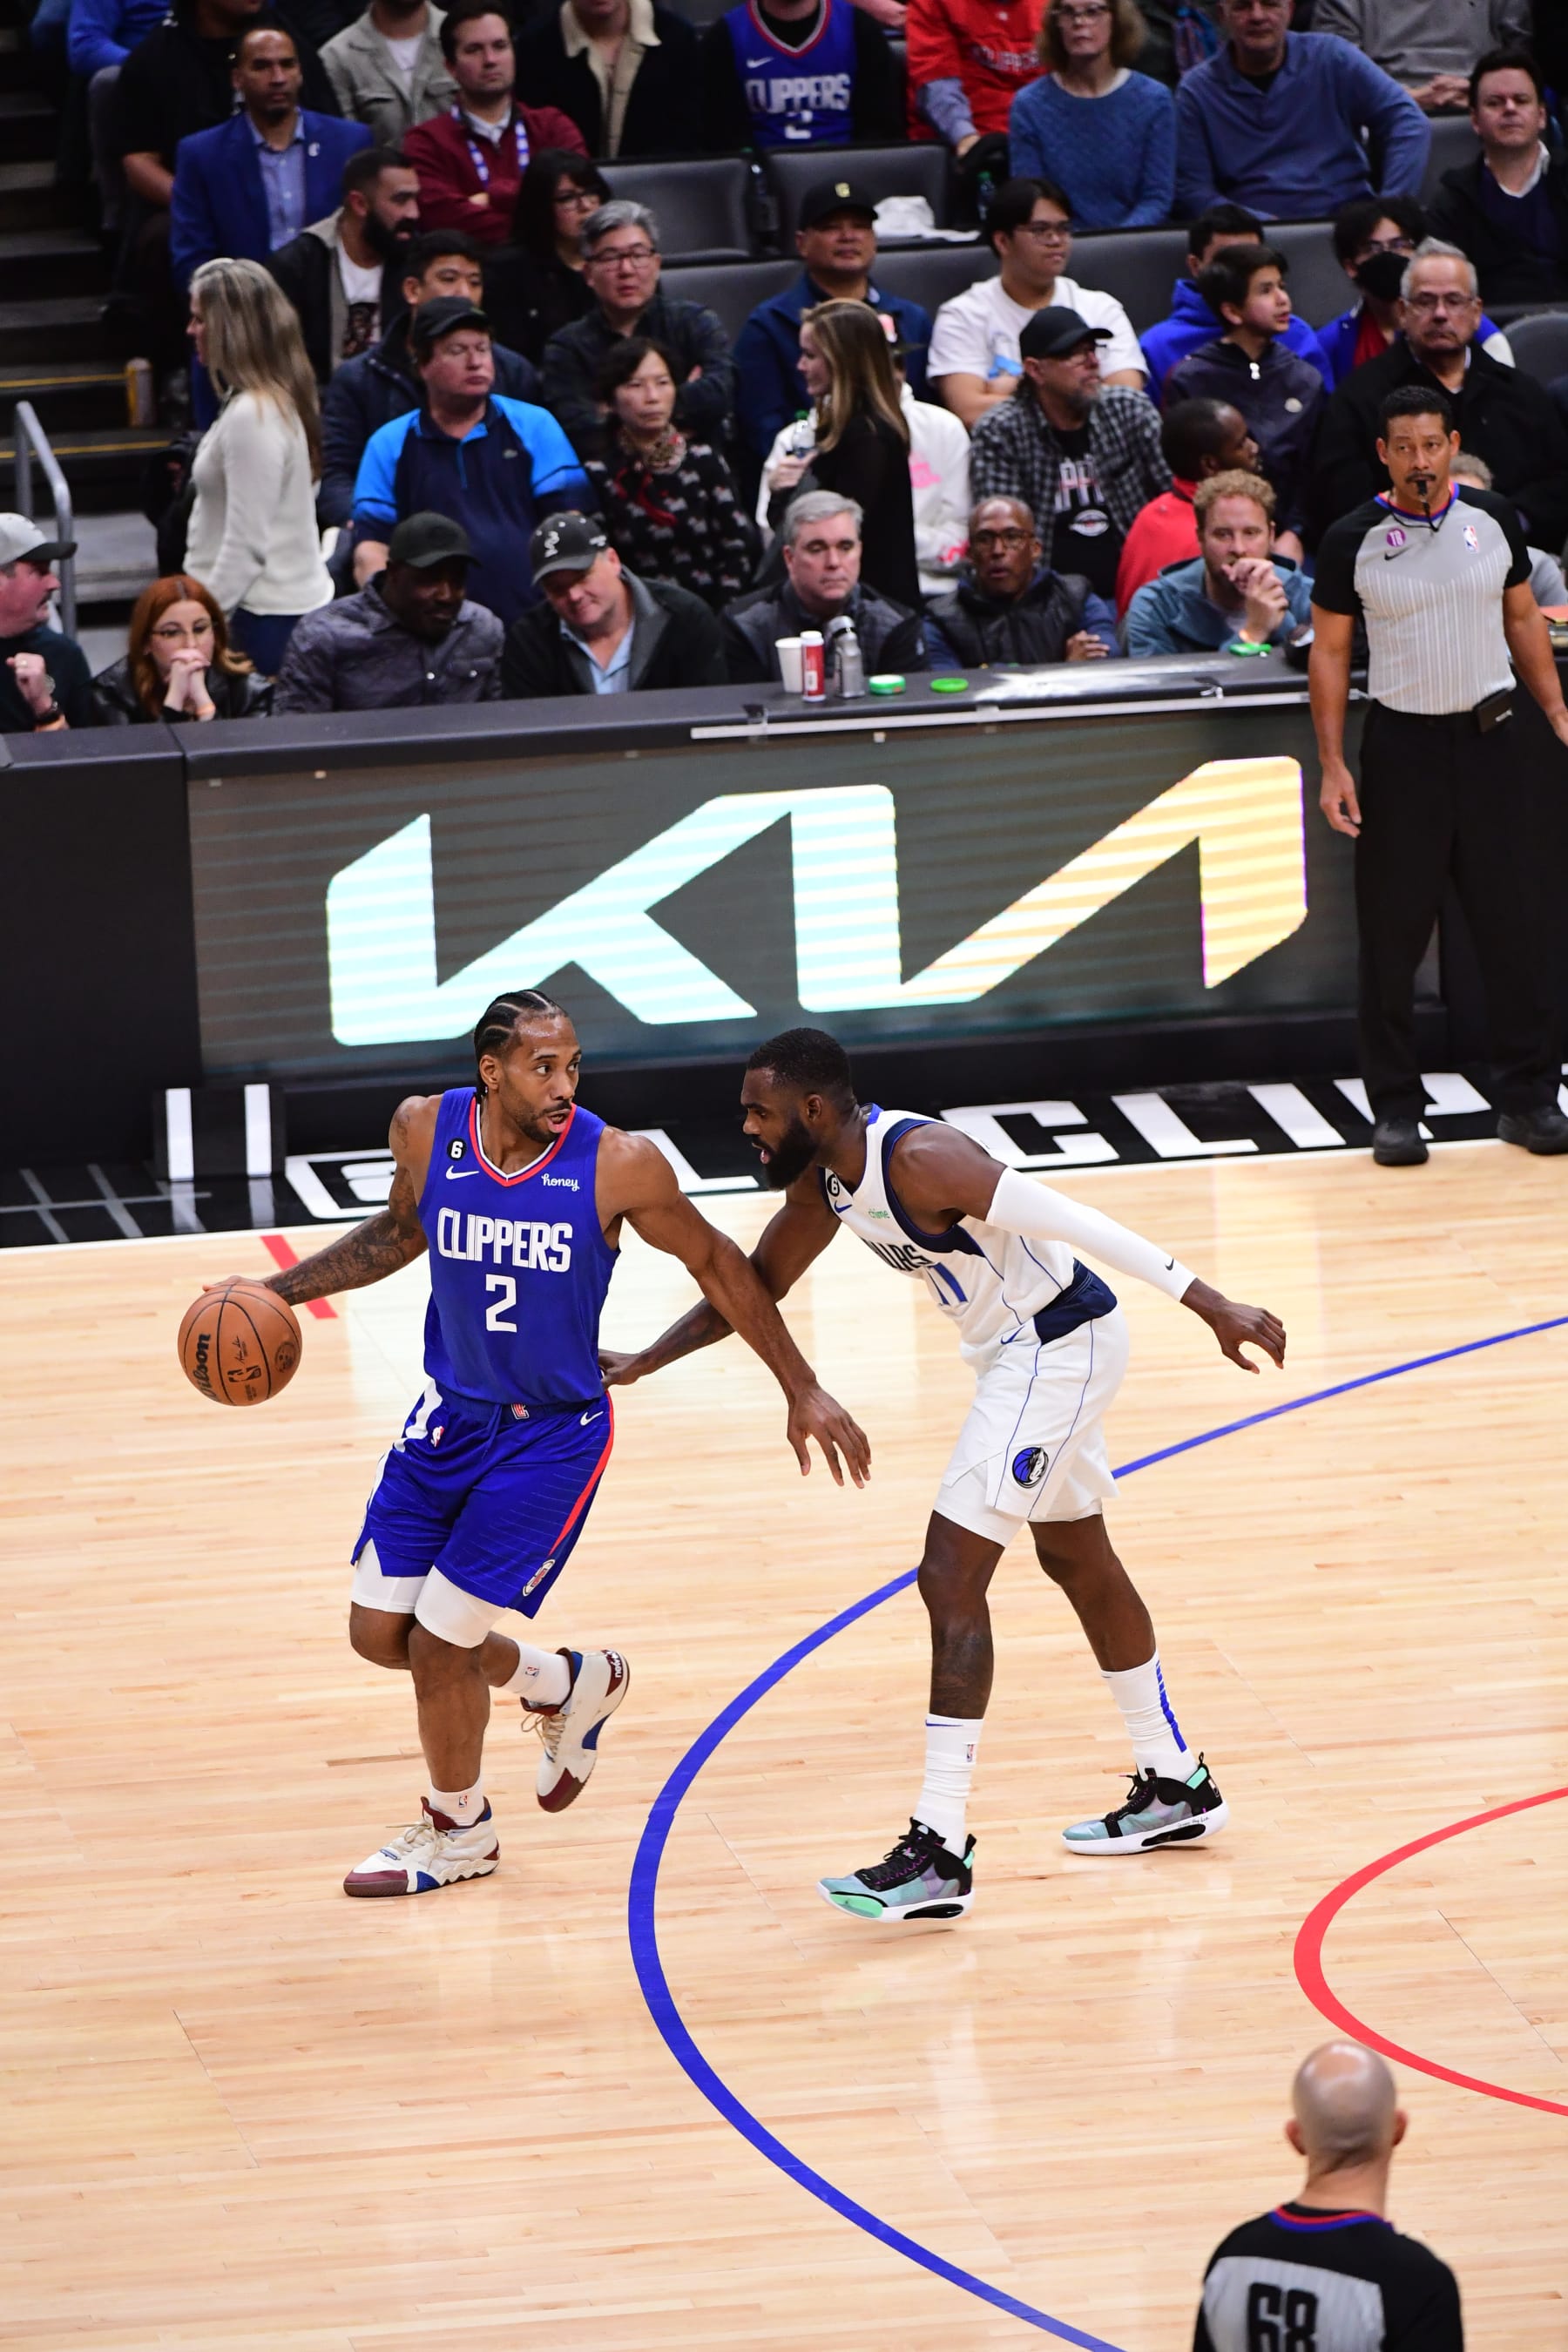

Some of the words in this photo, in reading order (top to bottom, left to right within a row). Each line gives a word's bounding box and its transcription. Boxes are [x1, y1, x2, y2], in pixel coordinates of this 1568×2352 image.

[745, 73, 851, 113] CLIPPERS
[785, 110, 812, 139] 2
[451, 1141, 463, 1159] 6
[541, 1173, 580, 1192] honey
[830, 1178, 839, 1194] 6
[437, 1207, 572, 1273] CLIPPERS
[485, 1274, 517, 1333] 2
[1247, 2281, 1318, 2352] 68
